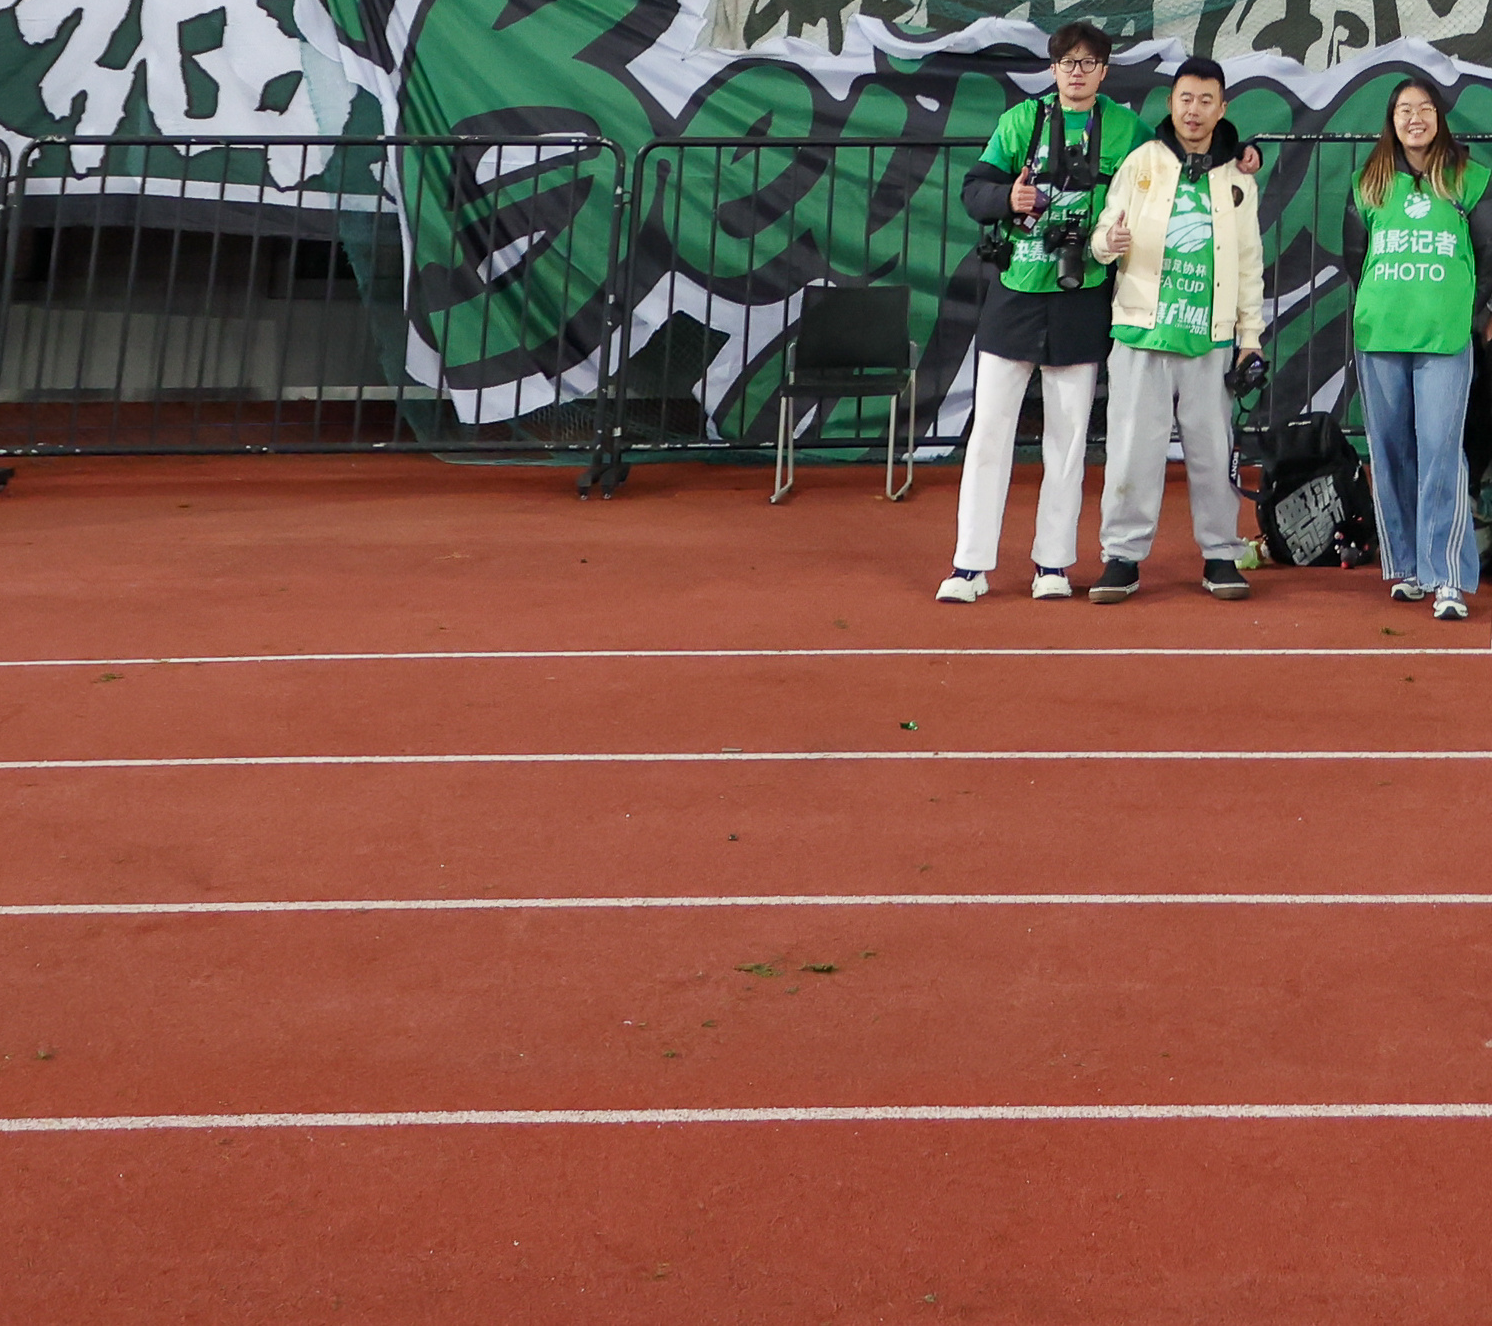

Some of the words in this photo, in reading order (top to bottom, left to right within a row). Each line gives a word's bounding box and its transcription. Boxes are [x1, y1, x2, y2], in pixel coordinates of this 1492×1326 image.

[1373, 261, 1446, 284] PHOTO
[1175, 277, 1206, 294] CUP
[1229, 450, 1240, 482] SONY
